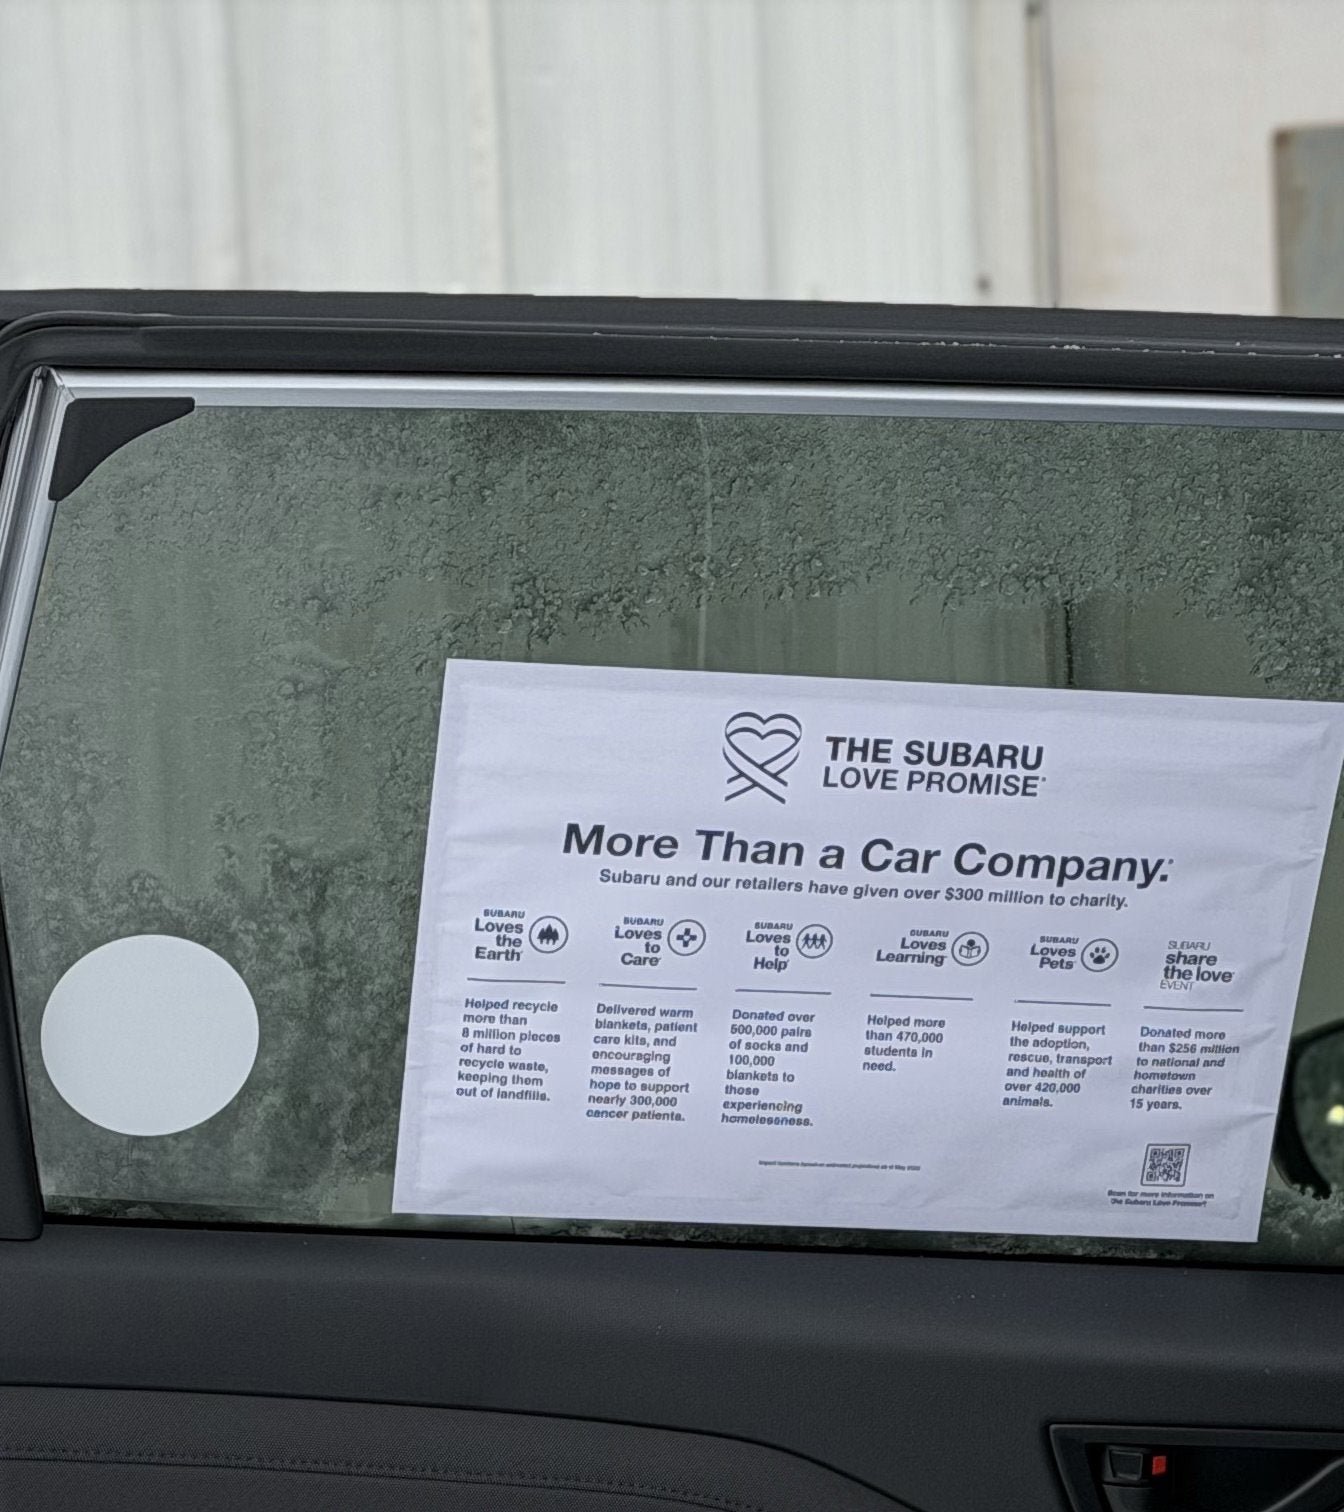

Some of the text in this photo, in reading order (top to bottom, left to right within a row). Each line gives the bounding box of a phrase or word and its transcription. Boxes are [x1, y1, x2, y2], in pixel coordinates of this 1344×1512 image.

[825, 736, 1043, 771] THE SUBARU
[822, 765, 899, 790] LOVE
[562, 822, 678, 858] More
[695, 829, 804, 866] Than
[818, 845, 844, 869] a
[861, 838, 941, 873] Car
[599, 868, 1128, 911] Subaru and our retailers have given over $300 million to charity.
[474, 917, 523, 934] Loves
[614, 925, 662, 940] Loves
[495, 934, 522, 947] the
[745, 930, 791, 944] Loves
[900, 937, 946, 951] Loves
[644, 941, 660, 953] to
[774, 944, 789, 957] to
[1029, 943, 1076, 957] Loves
[1165, 950, 1217, 966] share
[1163, 964, 1193, 980] the
[1159, 980, 1194, 991] EVENT
[464, 997, 558, 1014] Helped recycle
[596, 1002, 693, 1018] Delivered warm
[462, 1013, 527, 1025] more than
[732, 1008, 815, 1022] Donated over
[867, 1014, 945, 1029] Helped more
[594, 1018, 697, 1033] blankets, patient
[730, 1023, 812, 1039] 500,000 pairs
[1011, 1020, 1105, 1037] Helped support
[1140, 1025, 1226, 1040] Donated more
[461, 1026, 560, 1043] 8 million pieces
[593, 1033, 677, 1048] care kits, and
[865, 1029, 943, 1044] than 470,000
[460, 1042, 521, 1056] of hard to
[728, 1038, 808, 1052] of socks and
[1009, 1035, 1089, 1051] the adoption,
[1138, 1041, 1240, 1054] than $256 million
[864, 1045, 933, 1058] students in
[458, 1058, 548, 1073] recycle waste,
[729, 1054, 775, 1067] 100,000
[862, 1060, 896, 1071] need.
[1007, 1053, 1112, 1067] rescue, transport
[1136, 1056, 1225, 1067] to national and
[457, 1070, 543, 1086] keeping them
[590, 1065, 671, 1078] messages of
[726, 1068, 795, 1082] blankets to
[1006, 1066, 1086, 1079] and health of
[1133, 1069, 1196, 1080] hometown
[455, 1086, 477, 1097] out
[480, 1087, 493, 1098] of
[589, 1078, 689, 1094] hope to support
[724, 1084, 759, 1096] those
[1004, 1081, 1081, 1094] over 420,000
[1130, 1083, 1212, 1095] charities over
[587, 1094, 677, 1108] nearly 300,000
[1002, 1095, 1053, 1107] animals.
[1130, 1097, 1182, 1111] 15 years.
[585, 1109, 629, 1118] cancer
